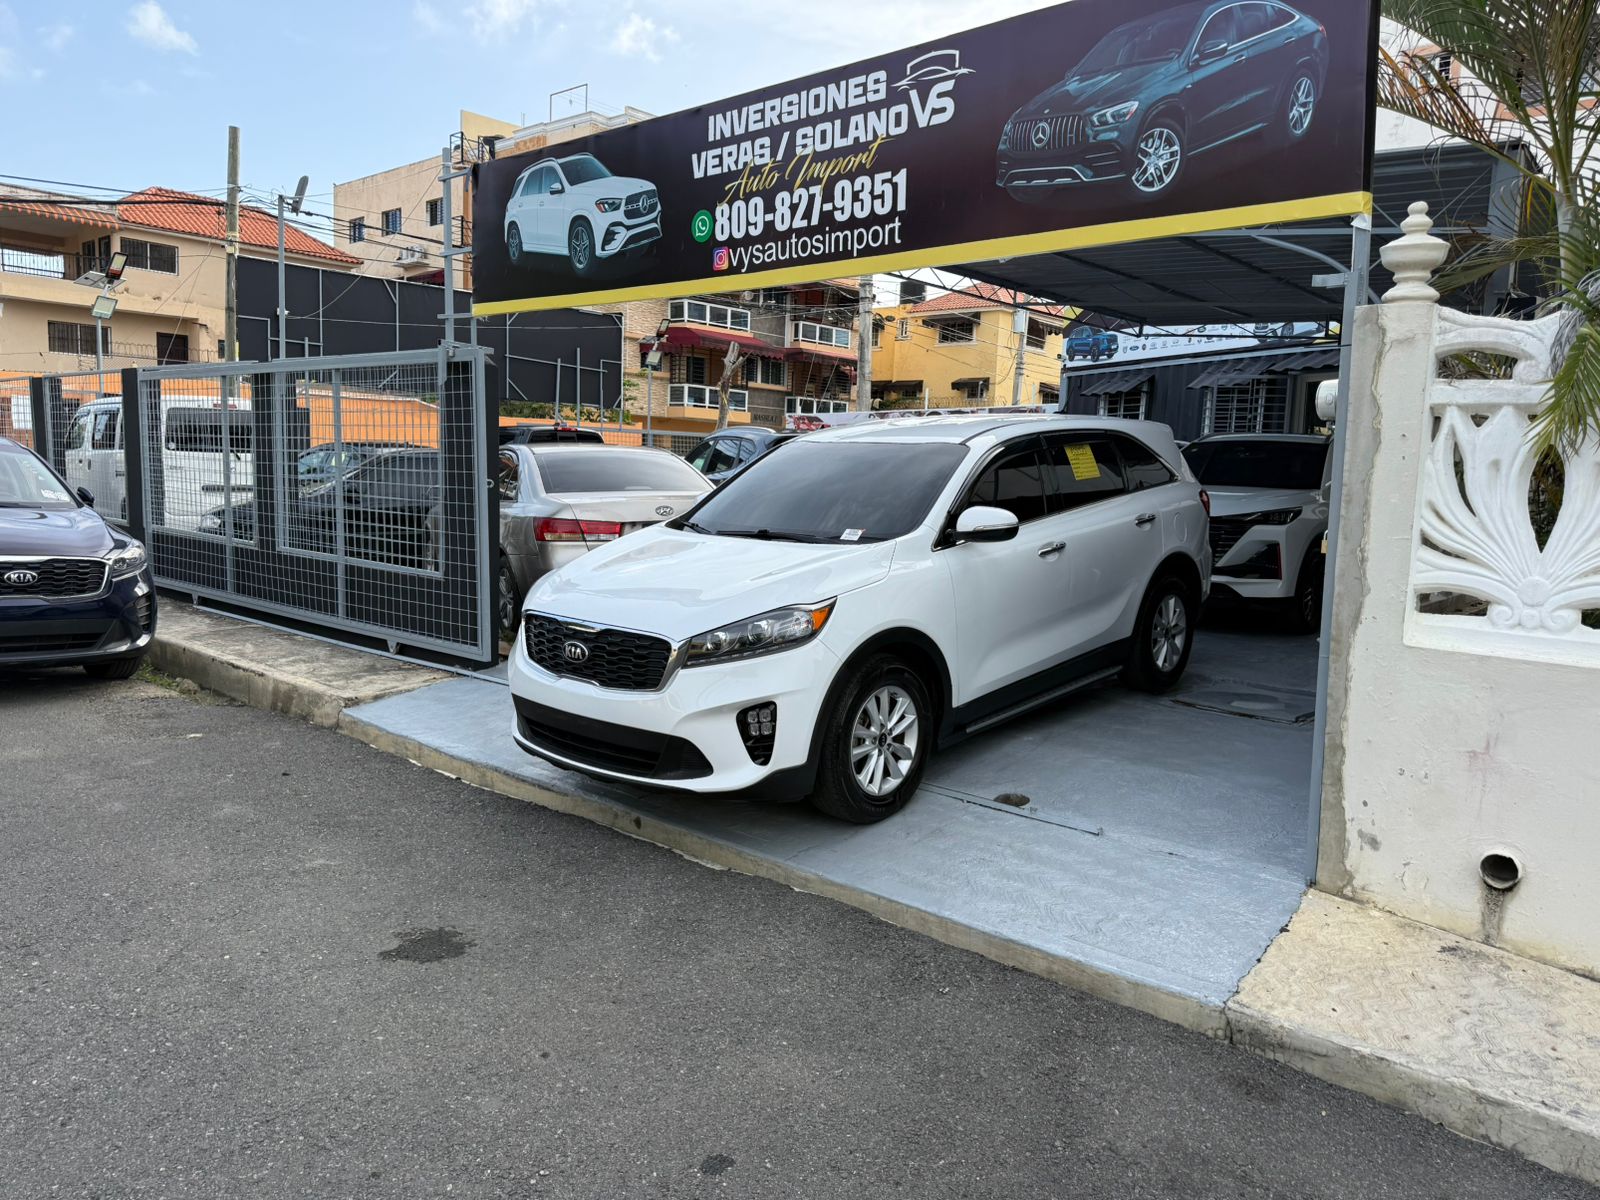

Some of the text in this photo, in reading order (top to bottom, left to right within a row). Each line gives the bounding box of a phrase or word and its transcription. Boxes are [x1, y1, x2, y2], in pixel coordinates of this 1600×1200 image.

[707, 70, 887, 142] INVERSIONES
[909, 79, 956, 129] VS
[691, 103, 909, 180] VERAS / SOLANO
[717, 133, 896, 207] Auto Import
[714, 167, 908, 242] 809-827-9351
[729, 216, 902, 273] vysautosimport
[10, 573, 33, 582] KIA
[565, 645, 583, 660] KIA
